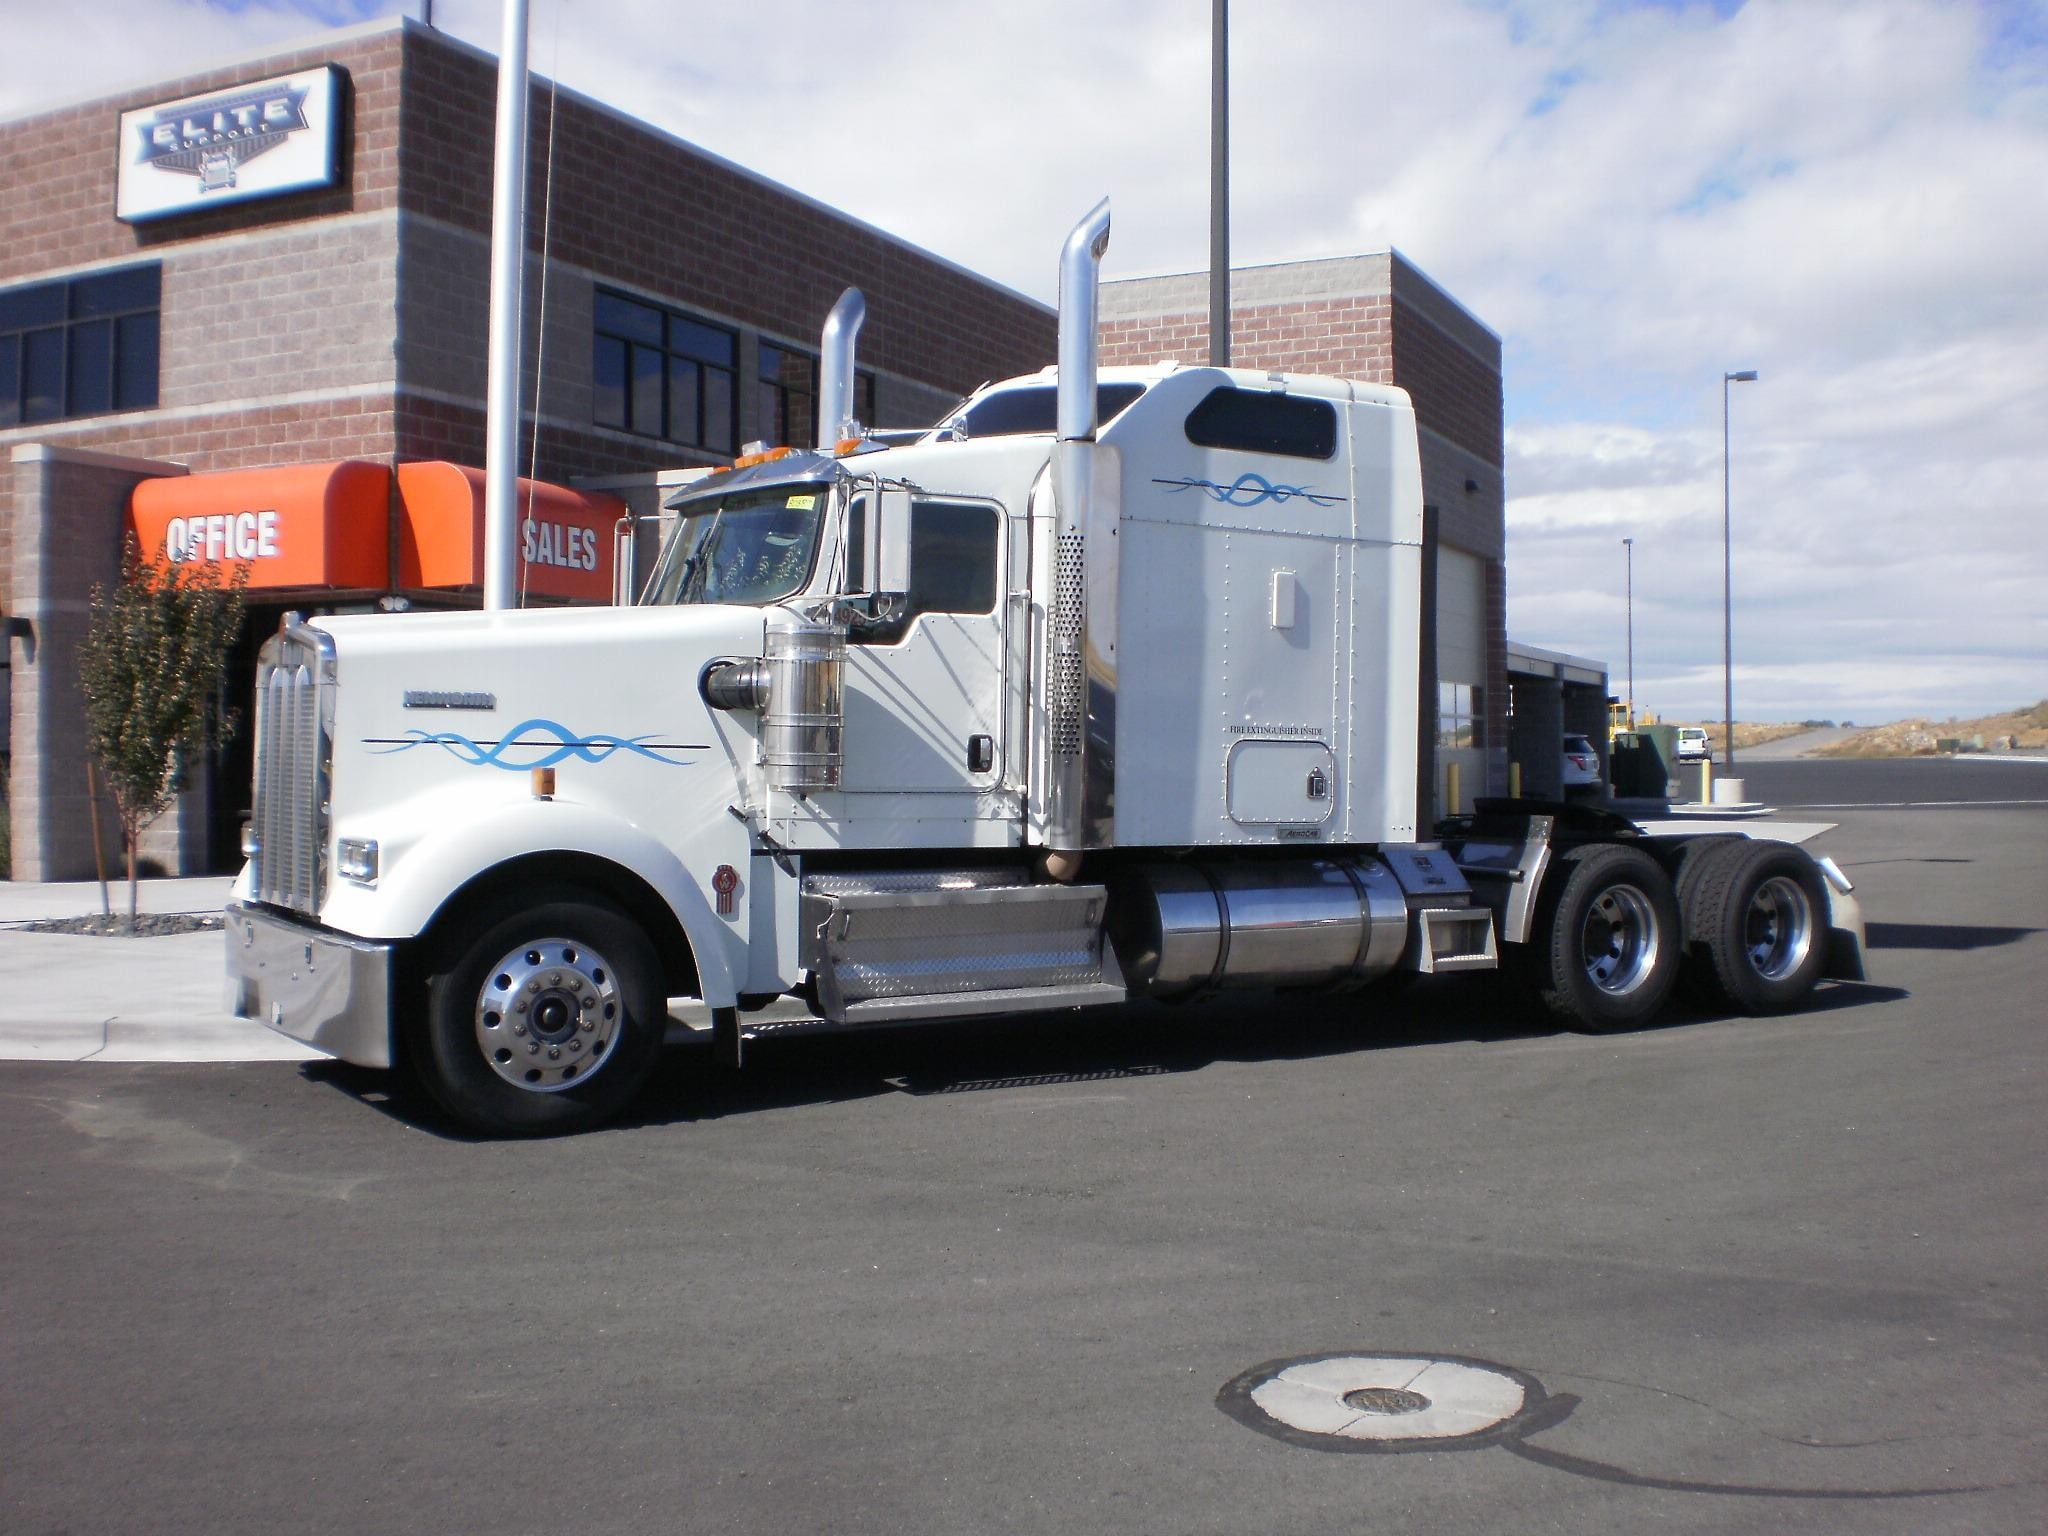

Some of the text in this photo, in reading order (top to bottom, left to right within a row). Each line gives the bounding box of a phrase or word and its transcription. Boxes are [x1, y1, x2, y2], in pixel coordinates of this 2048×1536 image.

[151, 97, 290, 145] ELITE
[168, 122, 271, 152] SUPPORT
[166, 510, 279, 564] OFFICE
[521, 518, 597, 571] SALES
[1230, 725, 1322, 736] FIRE EXTINGUISHER INSIDE
